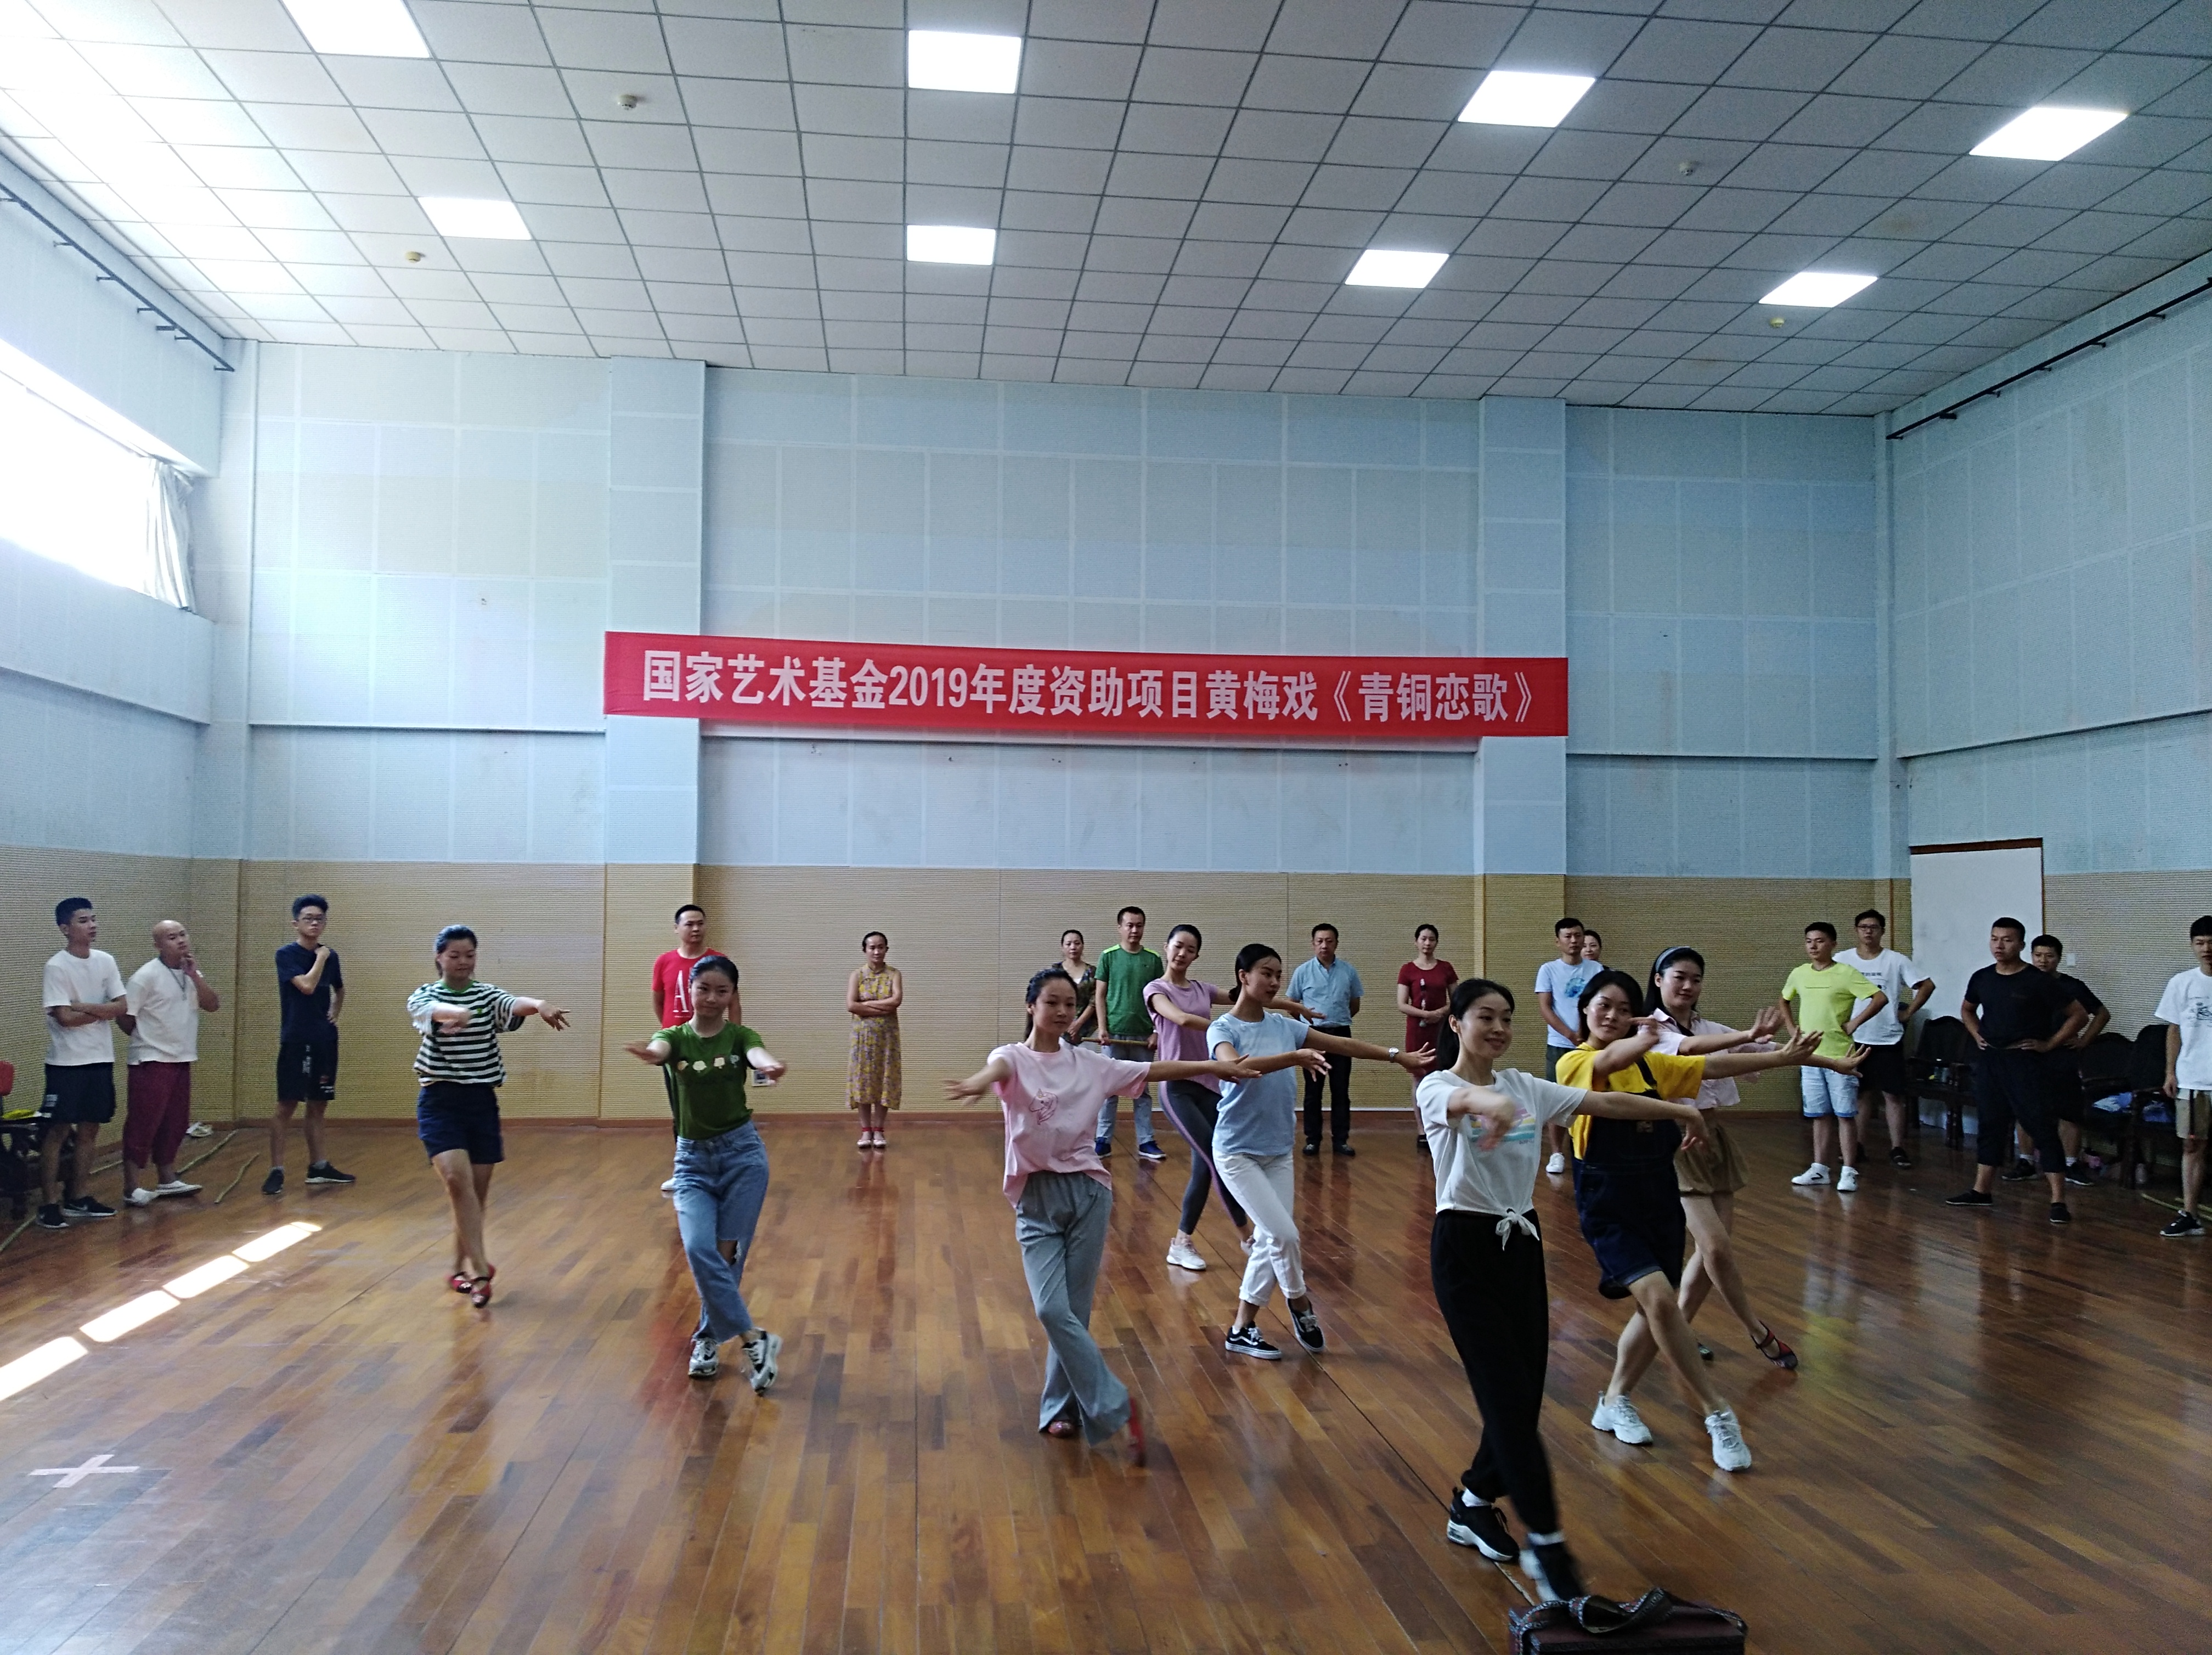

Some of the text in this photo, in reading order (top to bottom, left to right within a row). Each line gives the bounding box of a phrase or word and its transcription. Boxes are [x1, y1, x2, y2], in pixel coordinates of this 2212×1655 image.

[643, 650, 1533, 723] 国家艺术基金2019年度资助项目黄梅戏《青铜恋歌》
